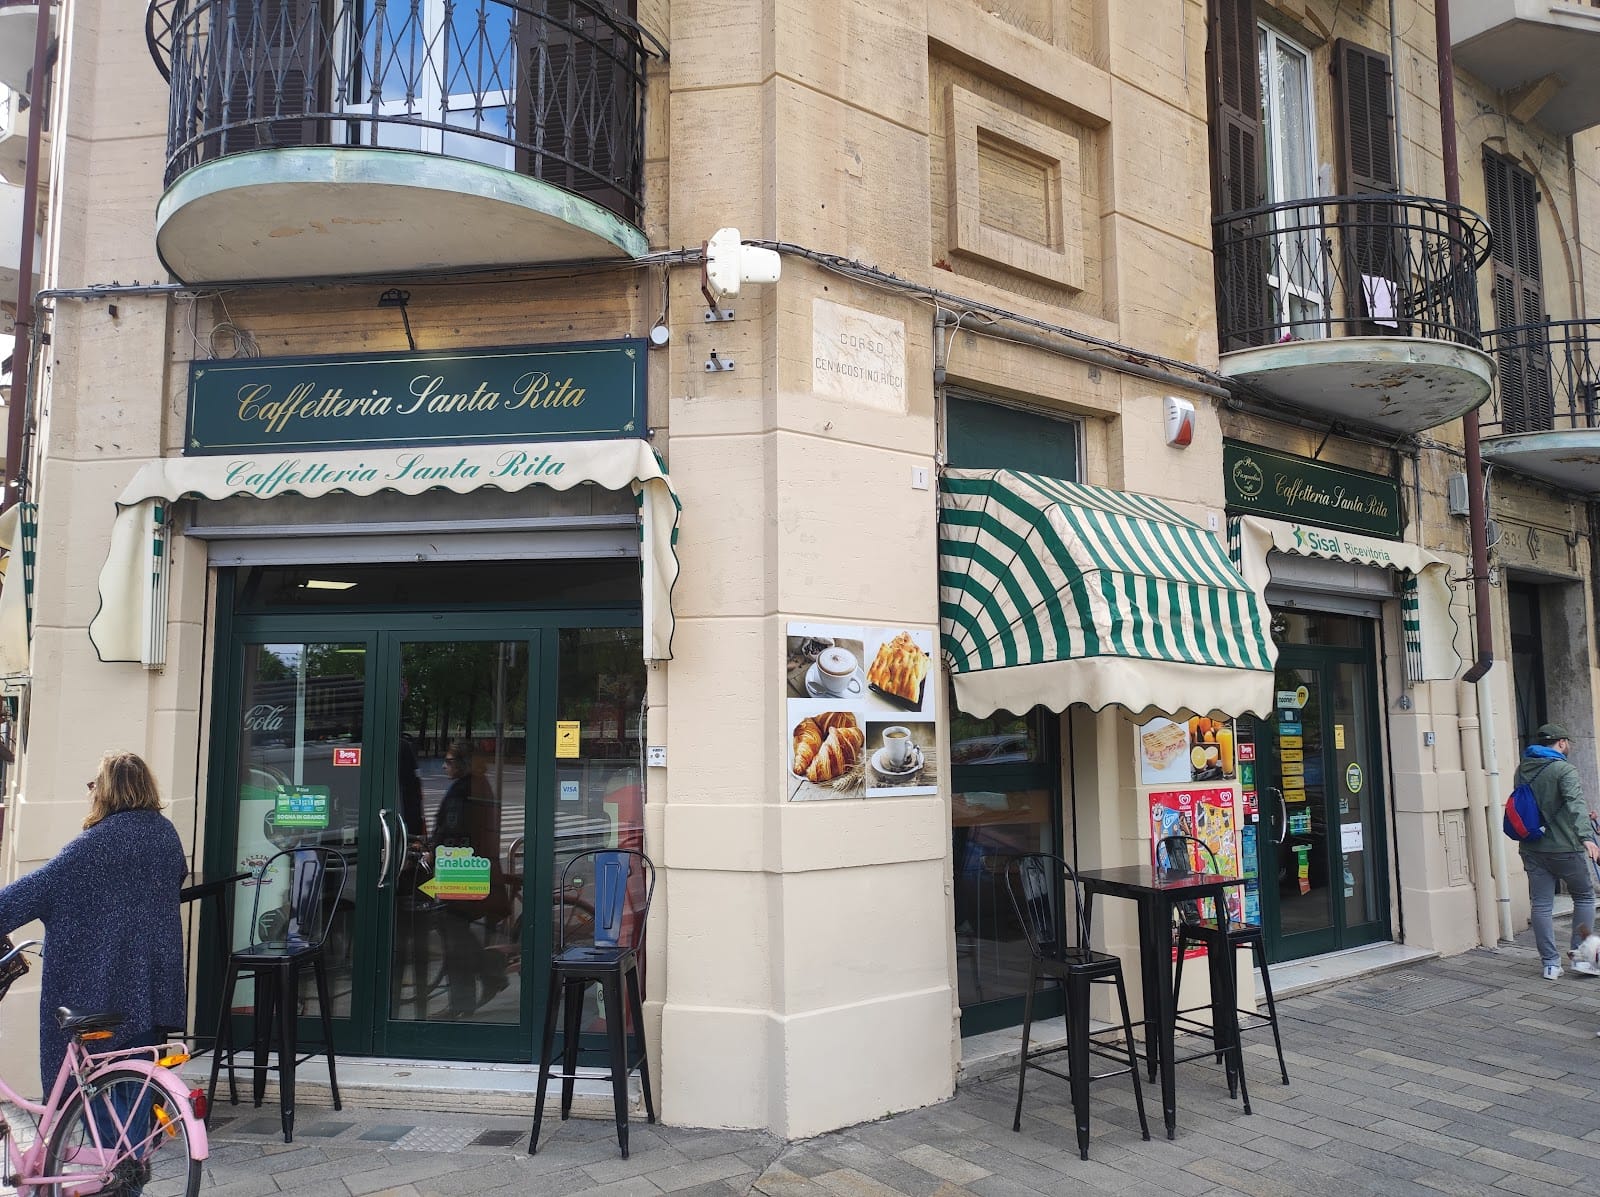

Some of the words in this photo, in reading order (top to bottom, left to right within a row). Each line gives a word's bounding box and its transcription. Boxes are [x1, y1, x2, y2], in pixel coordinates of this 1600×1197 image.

[840, 333, 884, 354] CORSO
[237, 382, 391, 433] Caffetteria
[397, 374, 500, 415] Santa
[504, 371, 585, 408] Rita
[226, 460, 377, 494] Caffetteria
[385, 453, 481, 481] Santa
[489, 450, 566, 477] Rita
[1274, 472, 1330, 506] Caffetteria
[1328, 485, 1364, 513] Santa
[1364, 494, 1389, 518] Rita
[1308, 531, 1340, 553] Sisal
[1344, 542, 1390, 561] Ricevitoria
[244, 704, 289, 731] Cola
[436, 857, 489, 868] Enalotto
